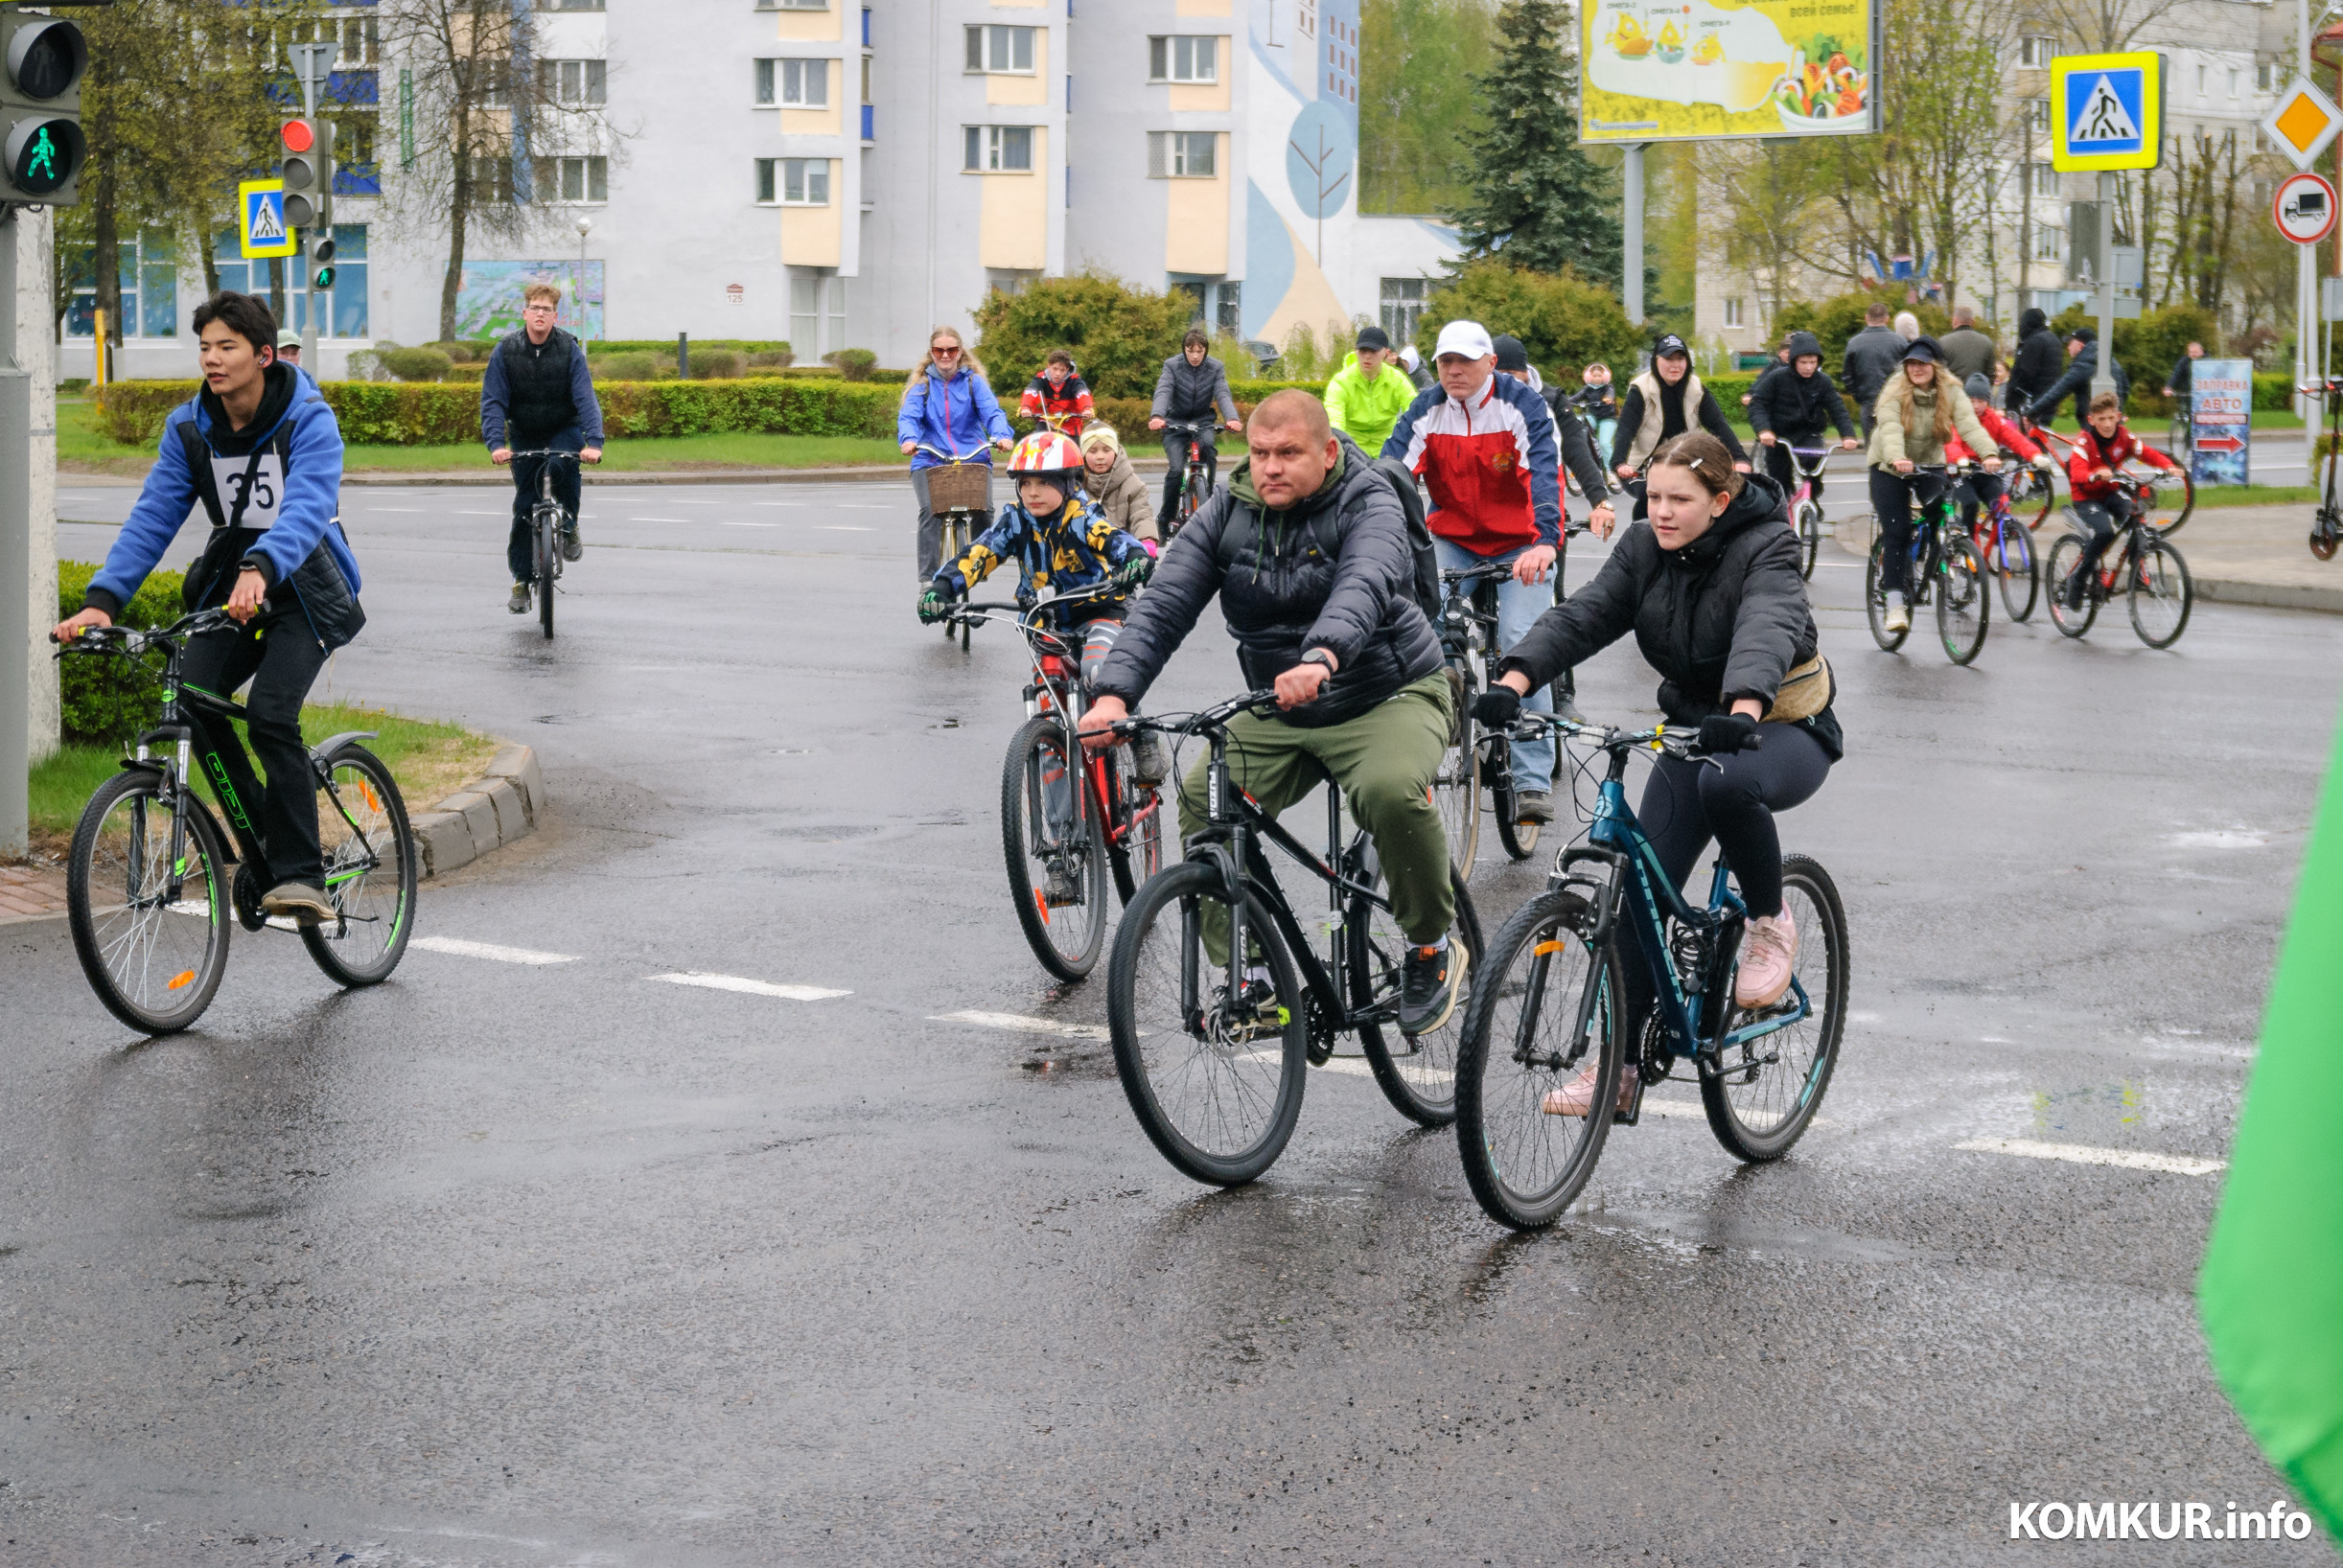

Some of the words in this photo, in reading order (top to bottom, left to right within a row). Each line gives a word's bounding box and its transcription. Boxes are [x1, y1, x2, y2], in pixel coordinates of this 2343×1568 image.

[1790, 2, 1816, 17] всей
[728, 294, 743, 303] 125
[2196, 380, 2248, 391] ЗАПРАВКА
[2203, 399, 2241, 409] АВТО
